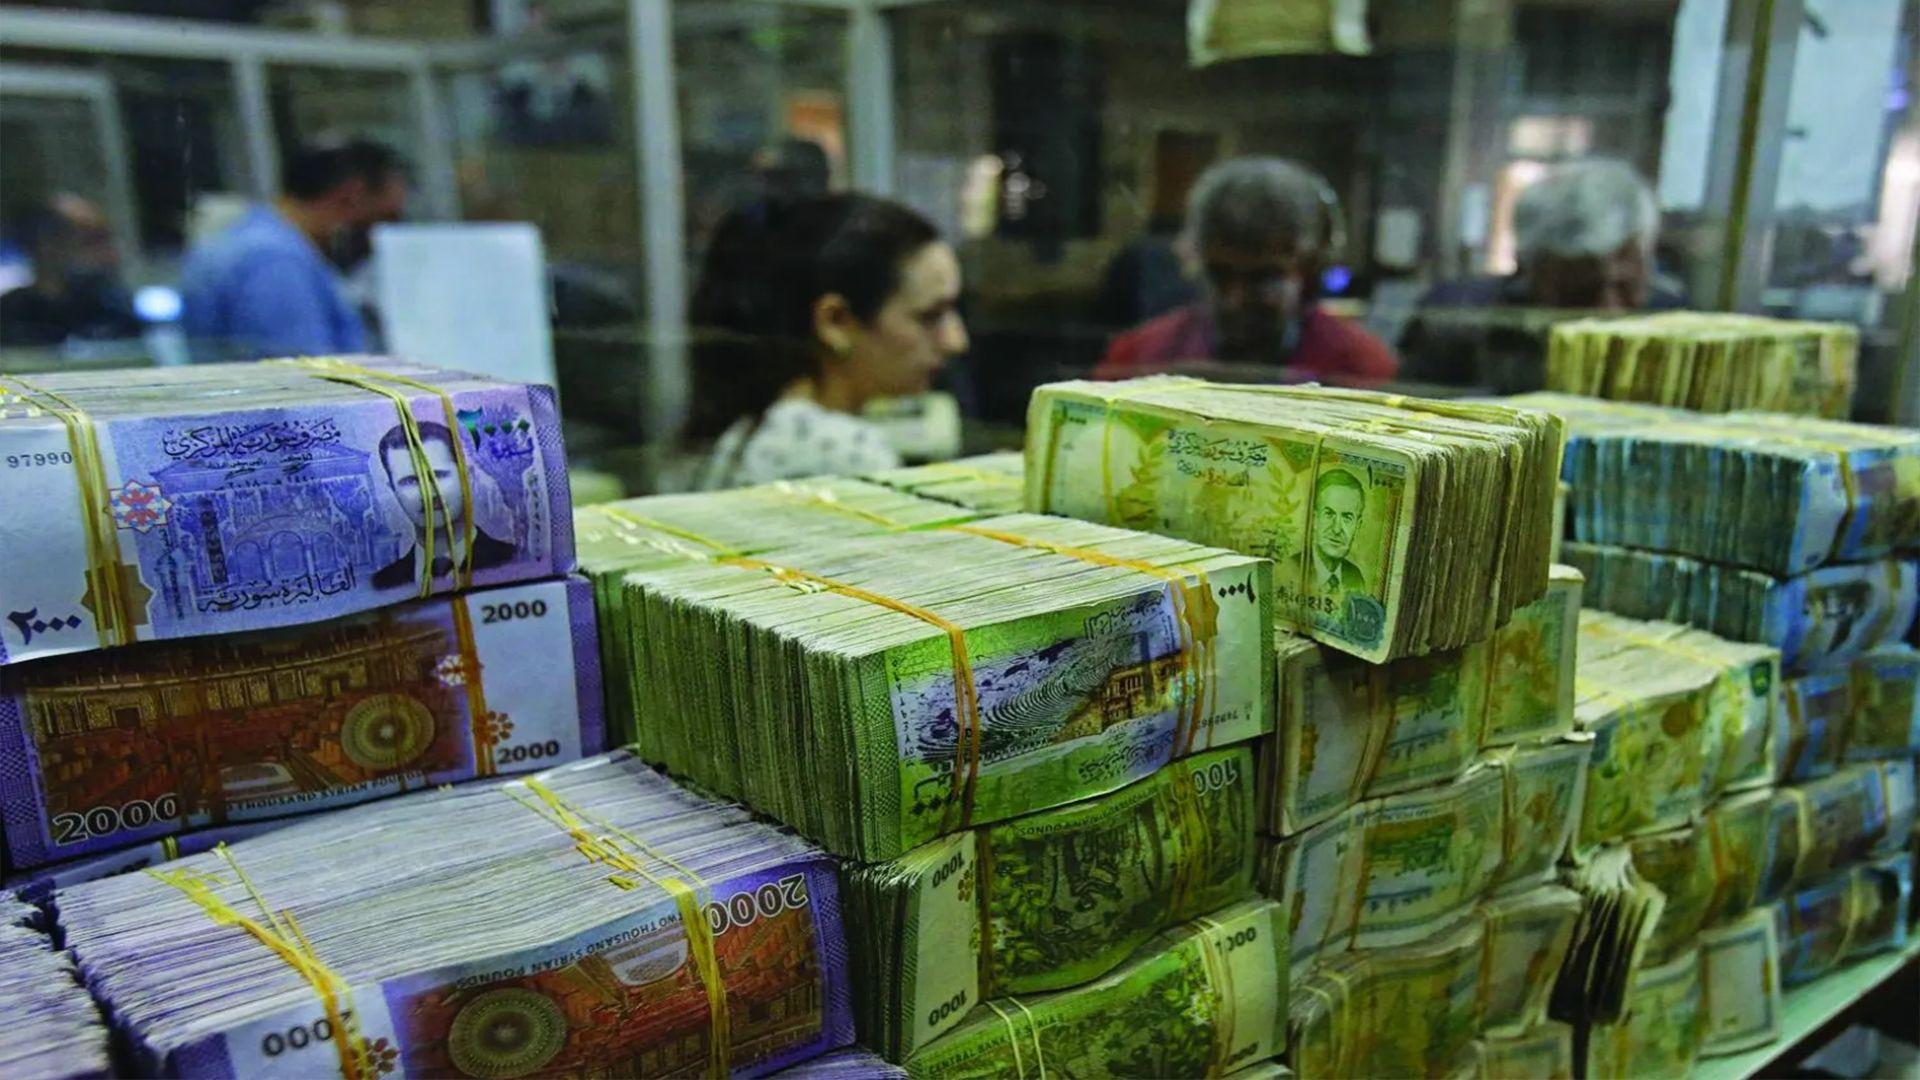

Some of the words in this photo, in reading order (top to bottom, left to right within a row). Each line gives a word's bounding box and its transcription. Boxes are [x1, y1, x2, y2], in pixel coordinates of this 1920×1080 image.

[6, 451, 73, 468] 97990
[7, 607, 82, 646] ٢٠٠٠
[481, 600, 547, 625] 2000
[498, 740, 560, 764] 2000
[52, 793, 178, 847] 2000
[931, 852, 965, 889] 1000
[700, 872, 809, 936] 2000
[586, 918, 657, 955] THOUSAND
[456, 964, 526, 989] POUNDS
[531, 949, 583, 972] SYRIAN
[928, 989, 967, 1026] 1000
